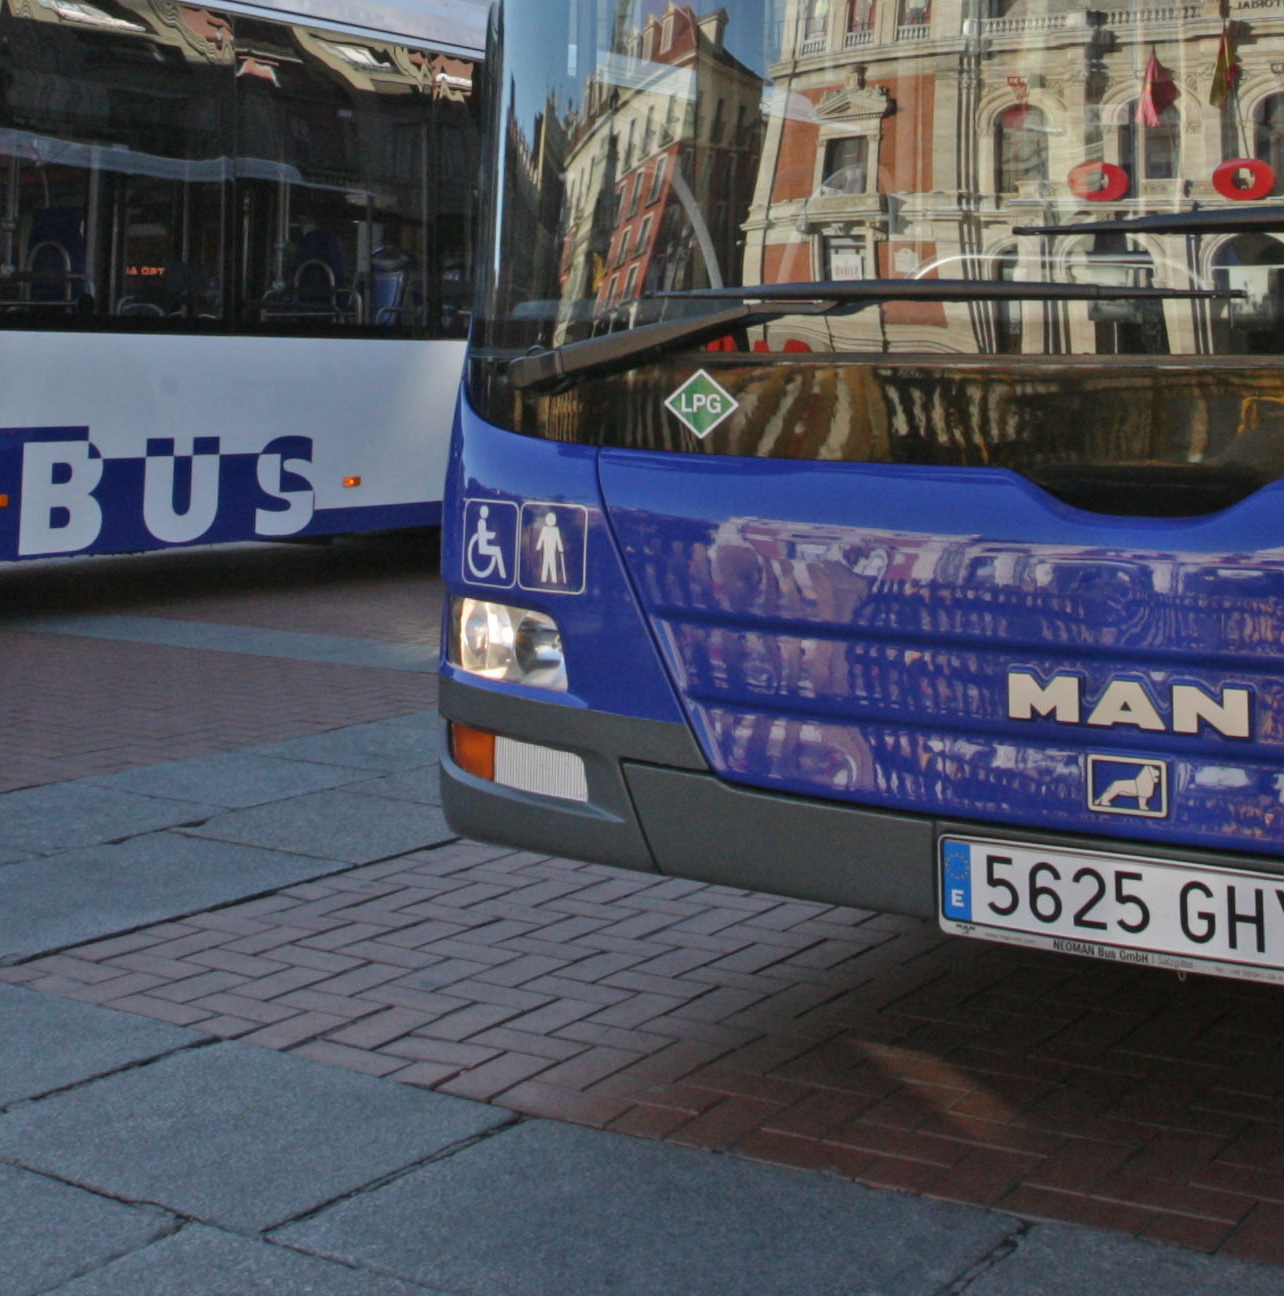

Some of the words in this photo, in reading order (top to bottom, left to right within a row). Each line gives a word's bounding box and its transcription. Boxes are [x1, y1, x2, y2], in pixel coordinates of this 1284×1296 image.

[680, 394, 723, 414] LPG
[18, 434, 316, 556] BUS
[1006, 671, 1251, 739] MAN
[950, 890, 965, 908] E
[985, 854, 1151, 934] 5625
[1053, 939, 1095, 956] NEOMAN
[1097, 945, 1117, 959] Bus
[1119, 950, 1149, 964] GmbH
